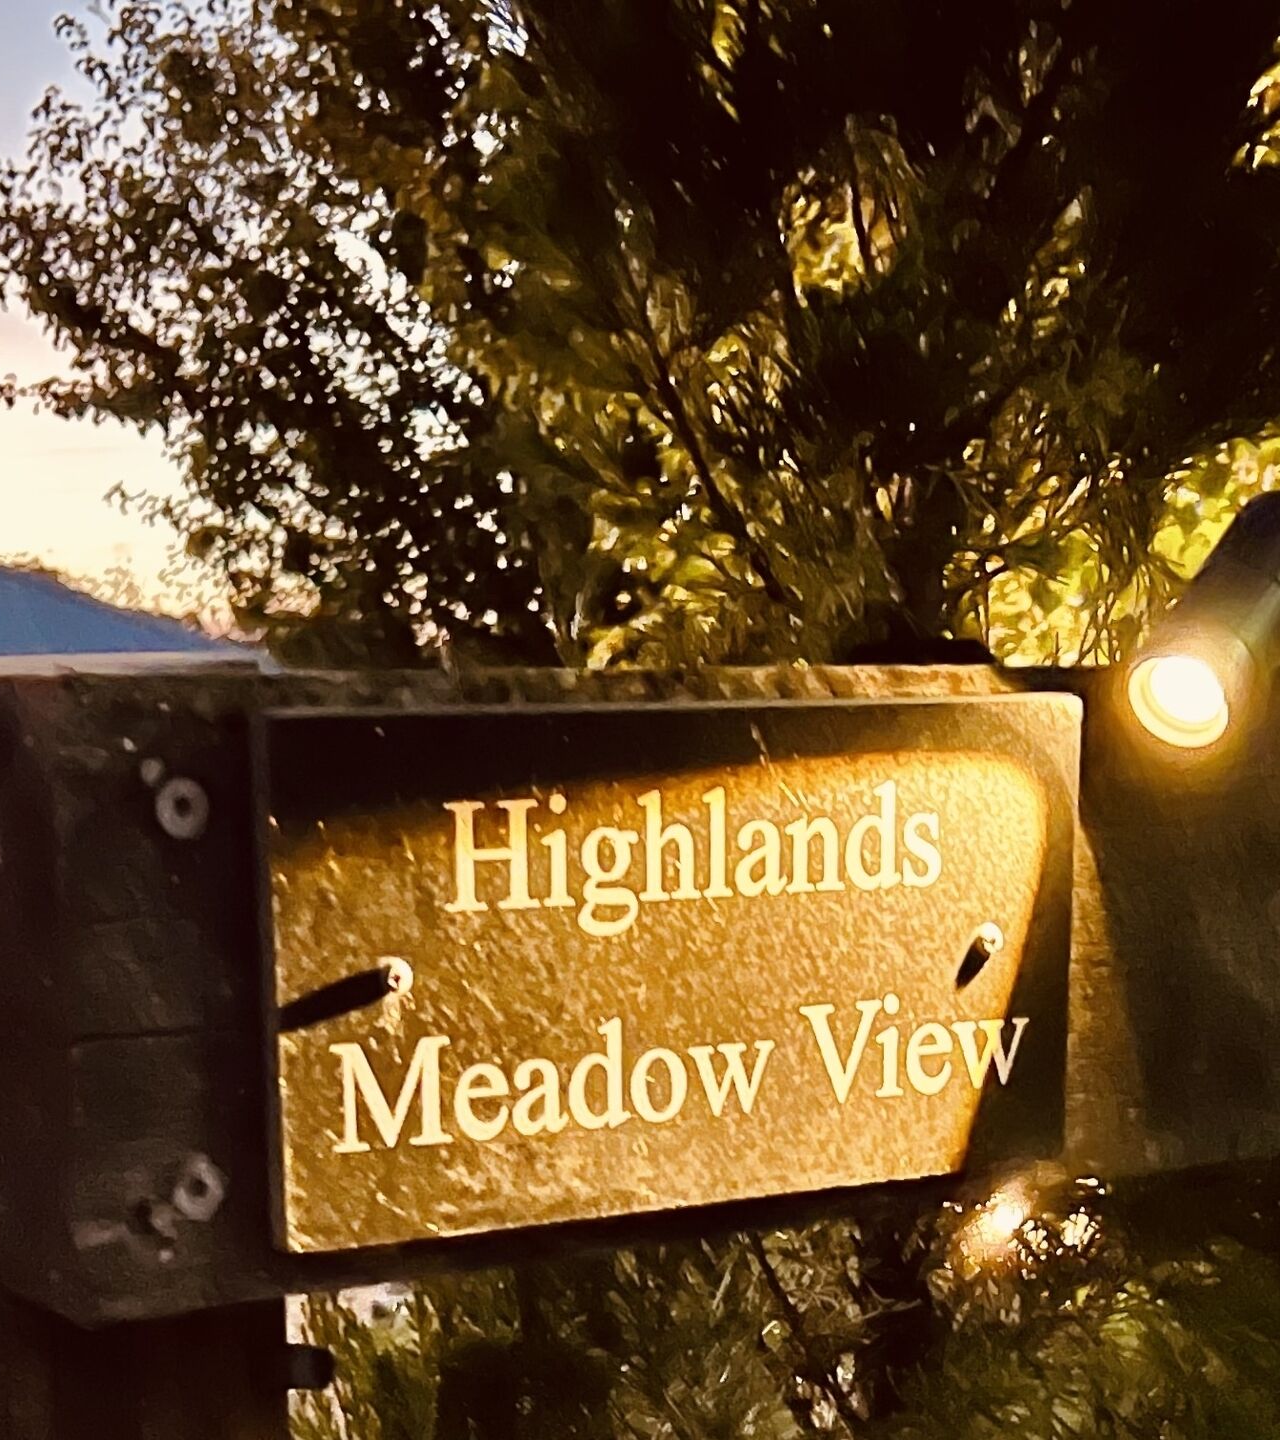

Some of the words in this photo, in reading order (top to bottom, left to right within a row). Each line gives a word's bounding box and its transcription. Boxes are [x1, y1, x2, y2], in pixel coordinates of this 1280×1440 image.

[444, 782, 943, 936] Highlands
[330, 1017, 775, 1154] Meadow
[800, 994, 1030, 1106] View
